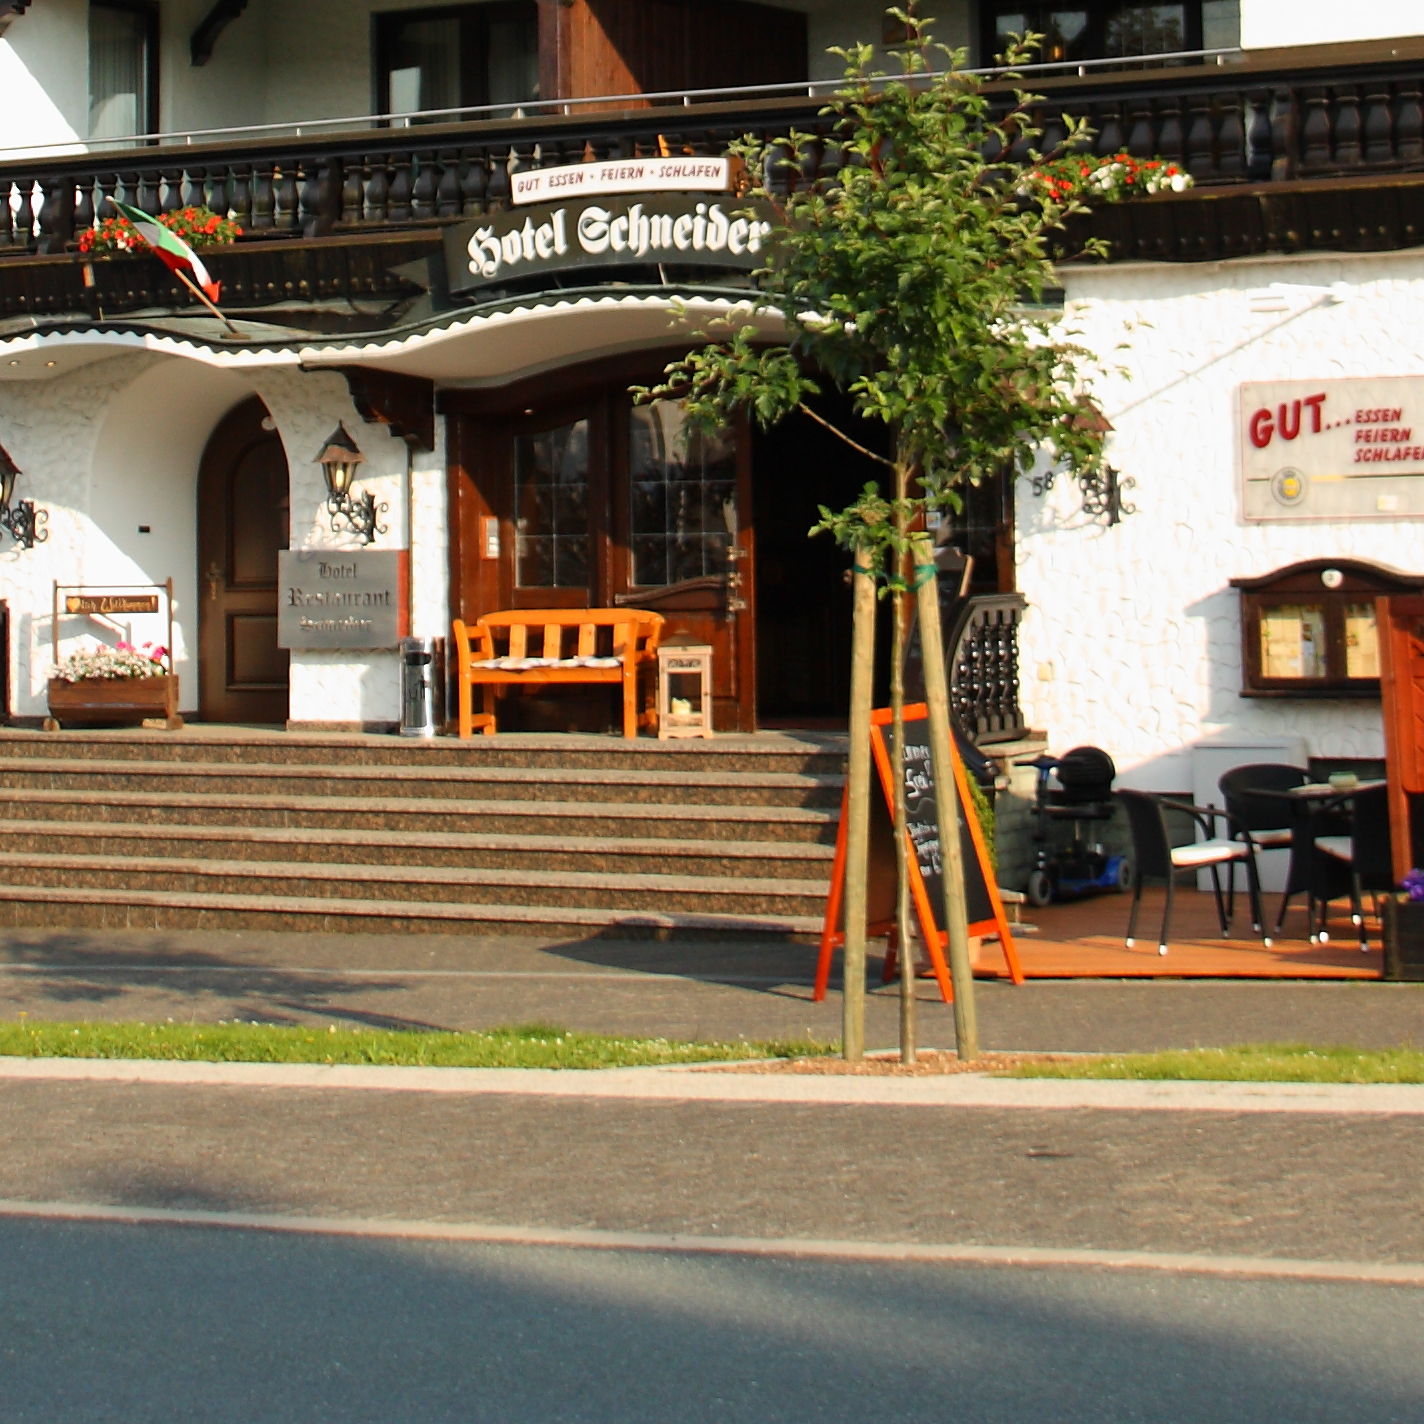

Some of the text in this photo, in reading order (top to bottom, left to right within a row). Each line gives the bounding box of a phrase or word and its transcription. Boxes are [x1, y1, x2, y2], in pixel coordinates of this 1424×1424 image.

[517, 165, 722, 193] GUT ESSEN FEIERN SCHLAFEN
[467, 203, 772, 277] Hotel Schneider
[1354, 408, 1402, 423] ESSEN
[1354, 428, 1411, 443] FEIERN
[1032, 470, 1054, 497] 58
[318, 561, 358, 579] Hotel
[288, 587, 392, 607] Restaurant
